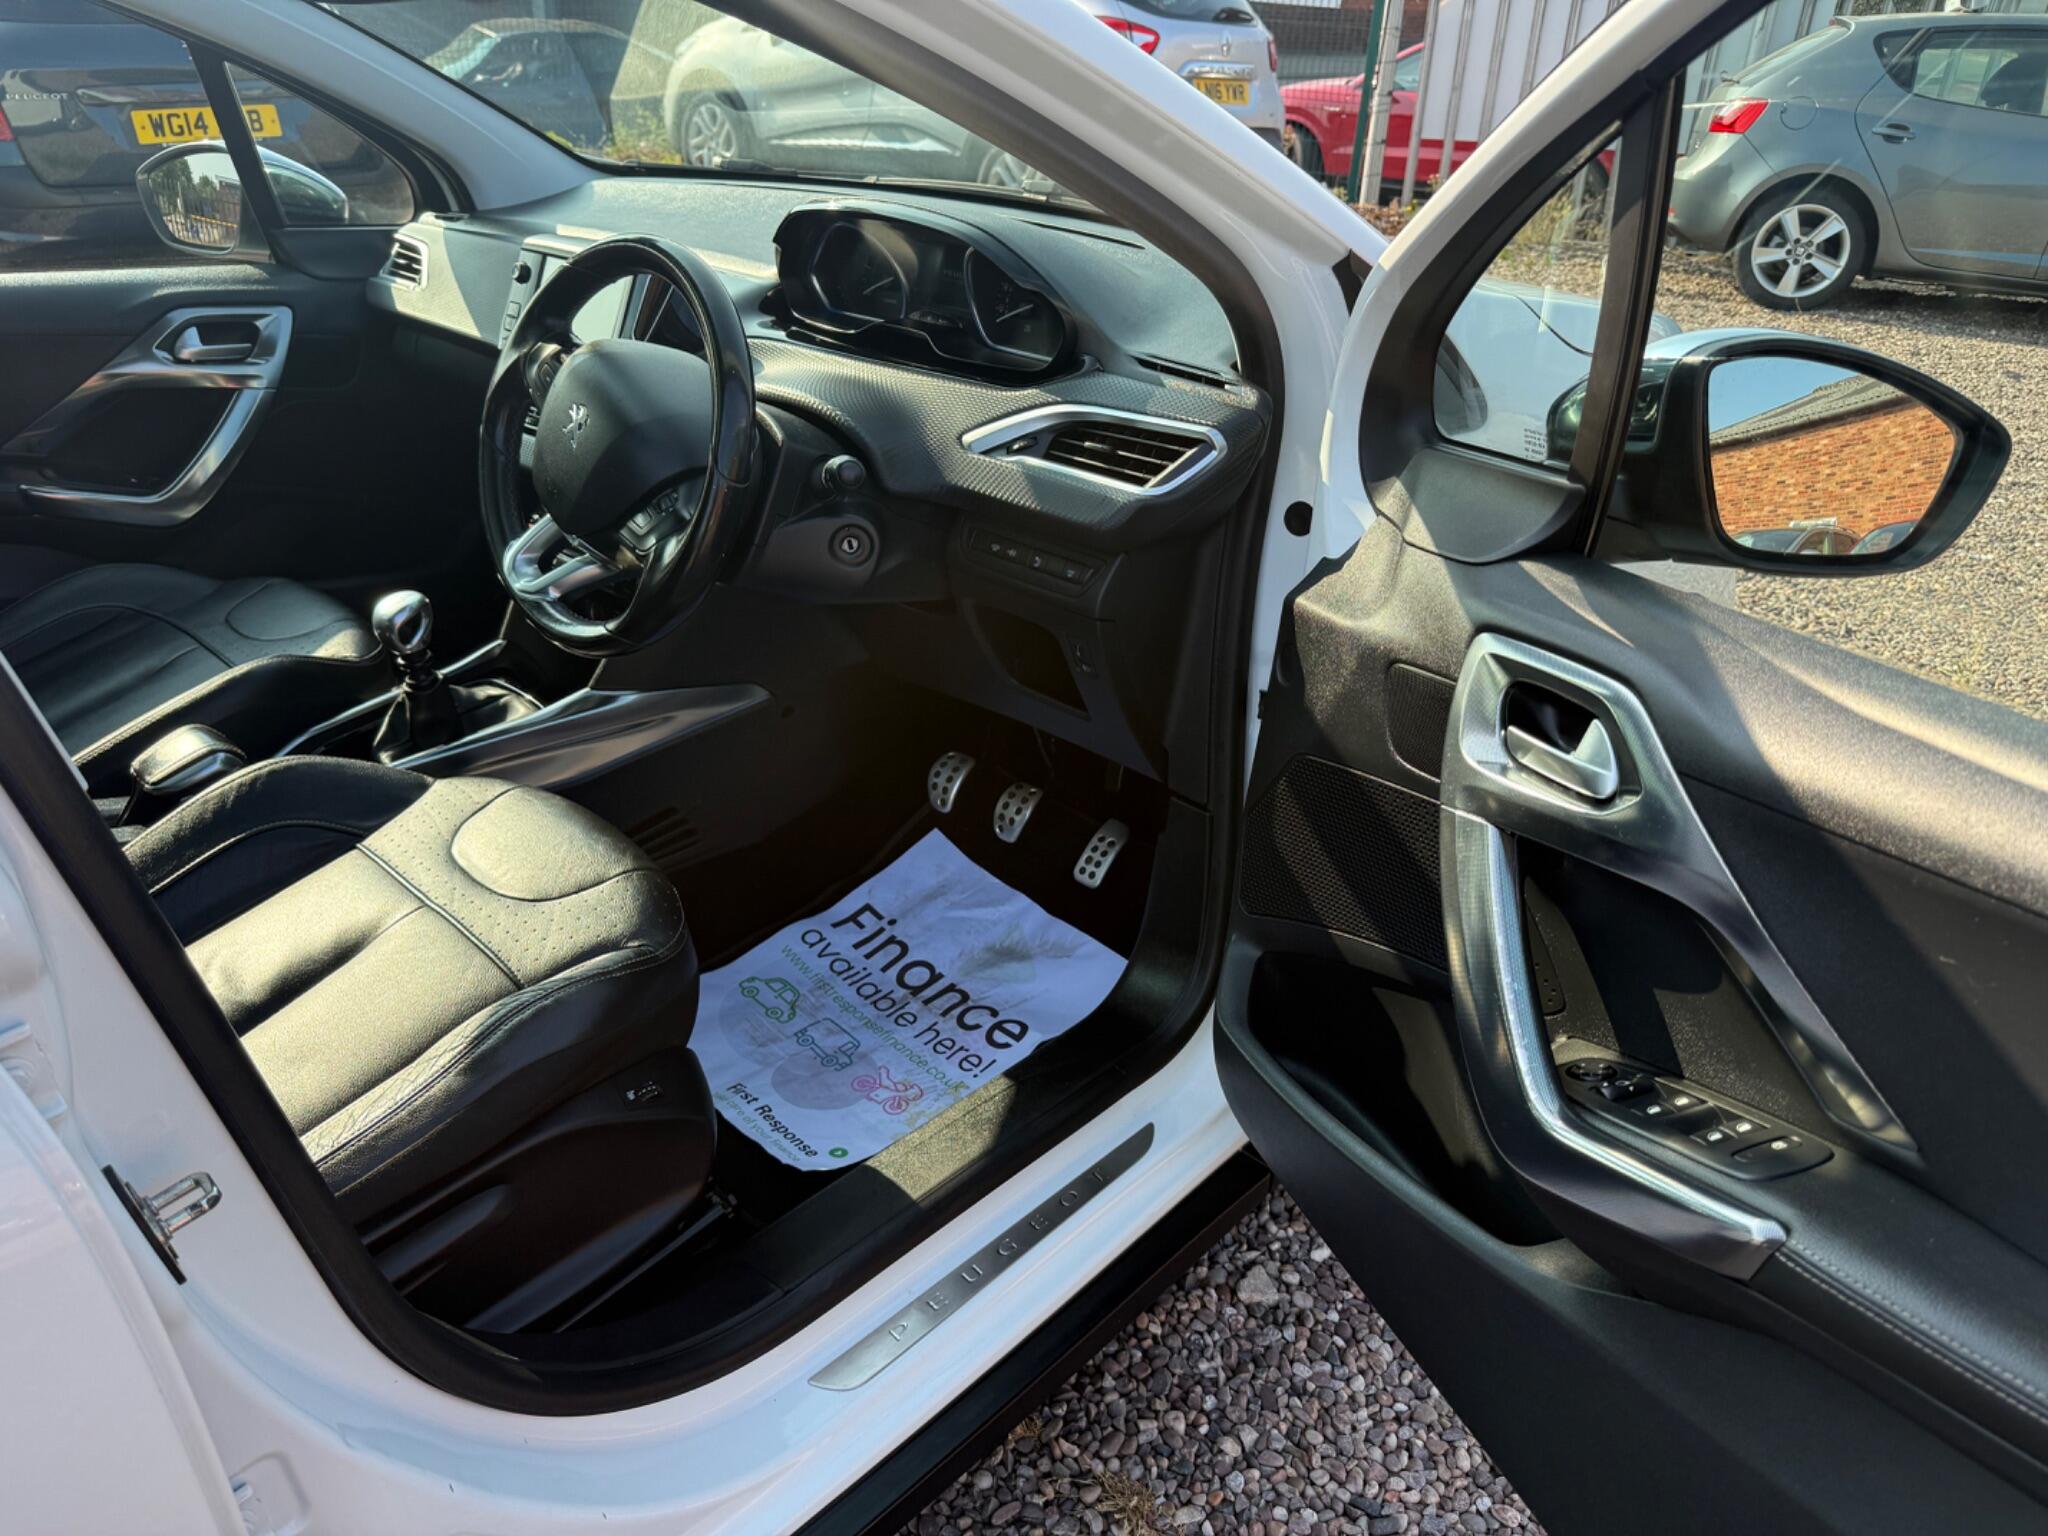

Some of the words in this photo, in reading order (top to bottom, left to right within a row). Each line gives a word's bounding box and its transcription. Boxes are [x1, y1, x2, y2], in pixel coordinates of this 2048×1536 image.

[147, 111, 209, 138] WG14
[781, 944, 971, 1095] www.firstresponsefinance.co.uk
[800, 928, 918, 1028] available
[913, 1021, 998, 1079] here!
[830, 902, 1029, 1050] Finance
[726, 1082, 760, 1105] First
[754, 1104, 819, 1158] Response
